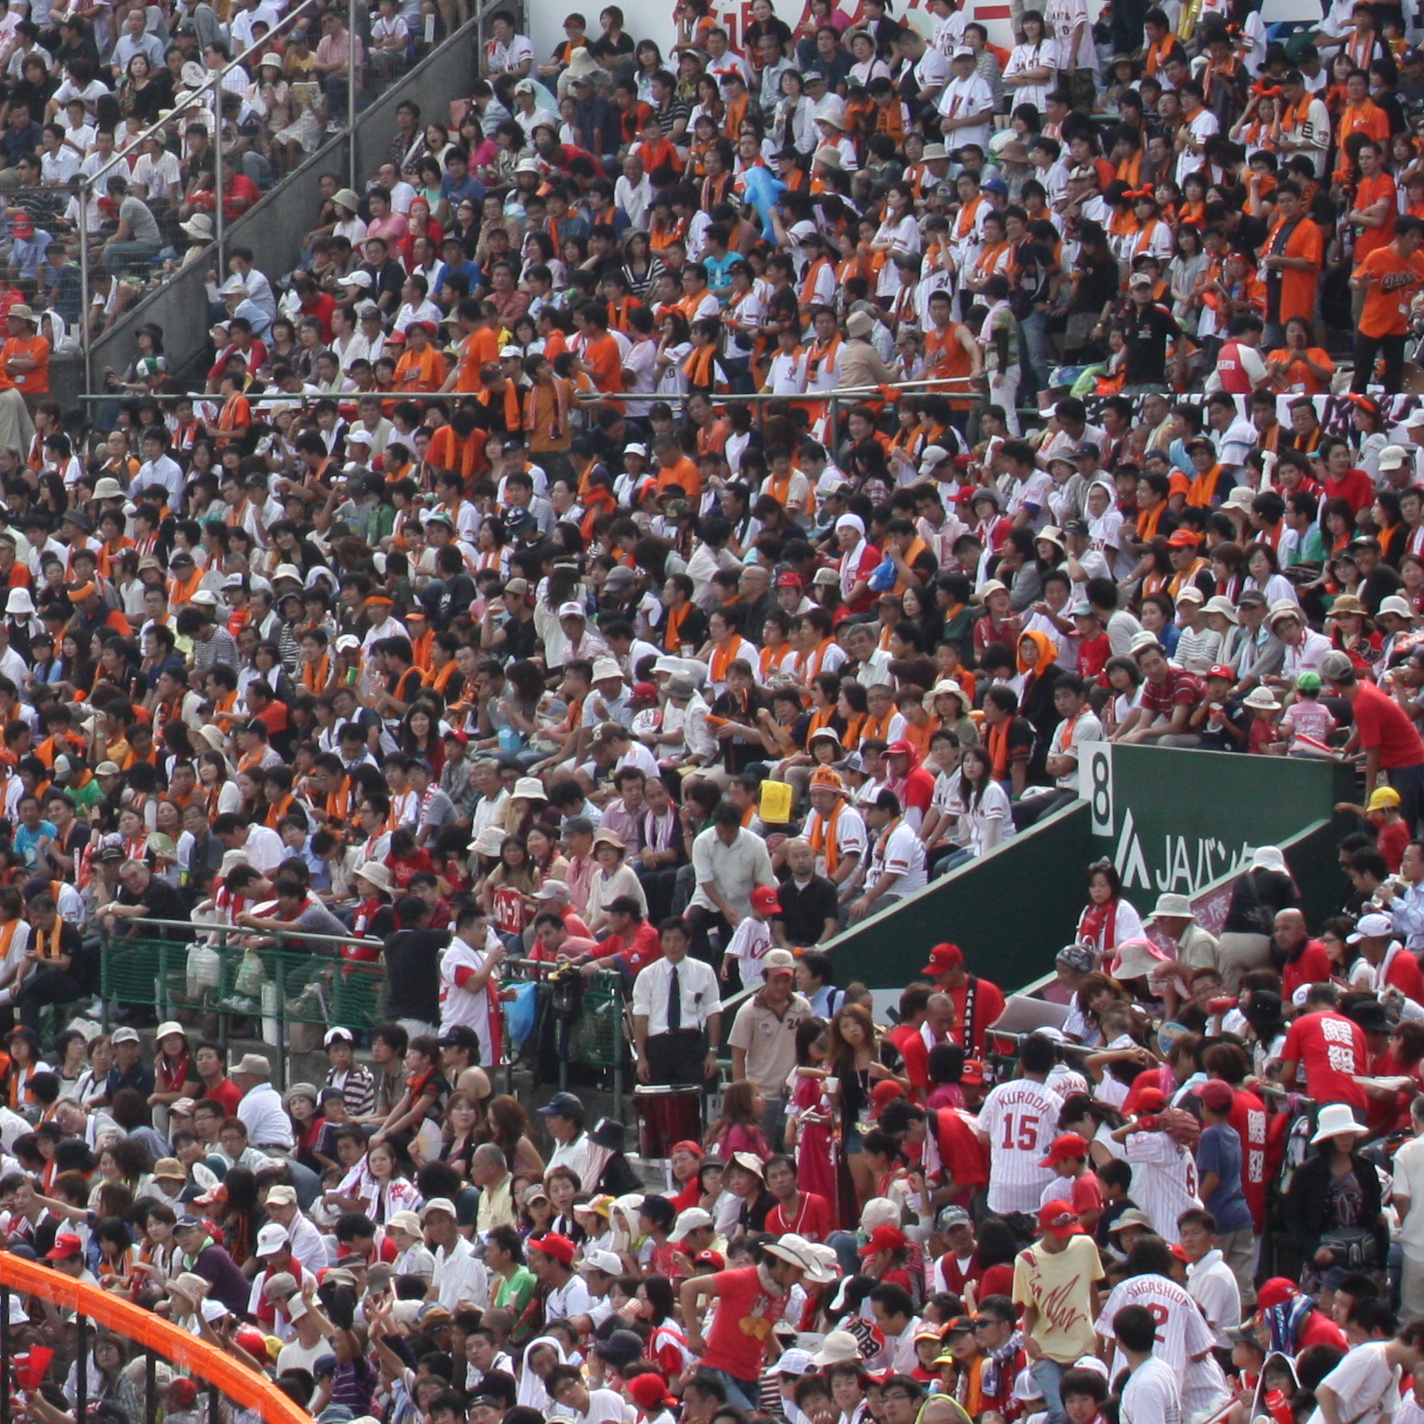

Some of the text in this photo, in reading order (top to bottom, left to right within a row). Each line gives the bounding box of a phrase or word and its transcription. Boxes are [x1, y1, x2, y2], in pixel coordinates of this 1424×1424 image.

[1091, 750, 1109, 827] 8
[998, 1090, 1051, 1115] KURODA
[1002, 1112, 1039, 1151] 15
